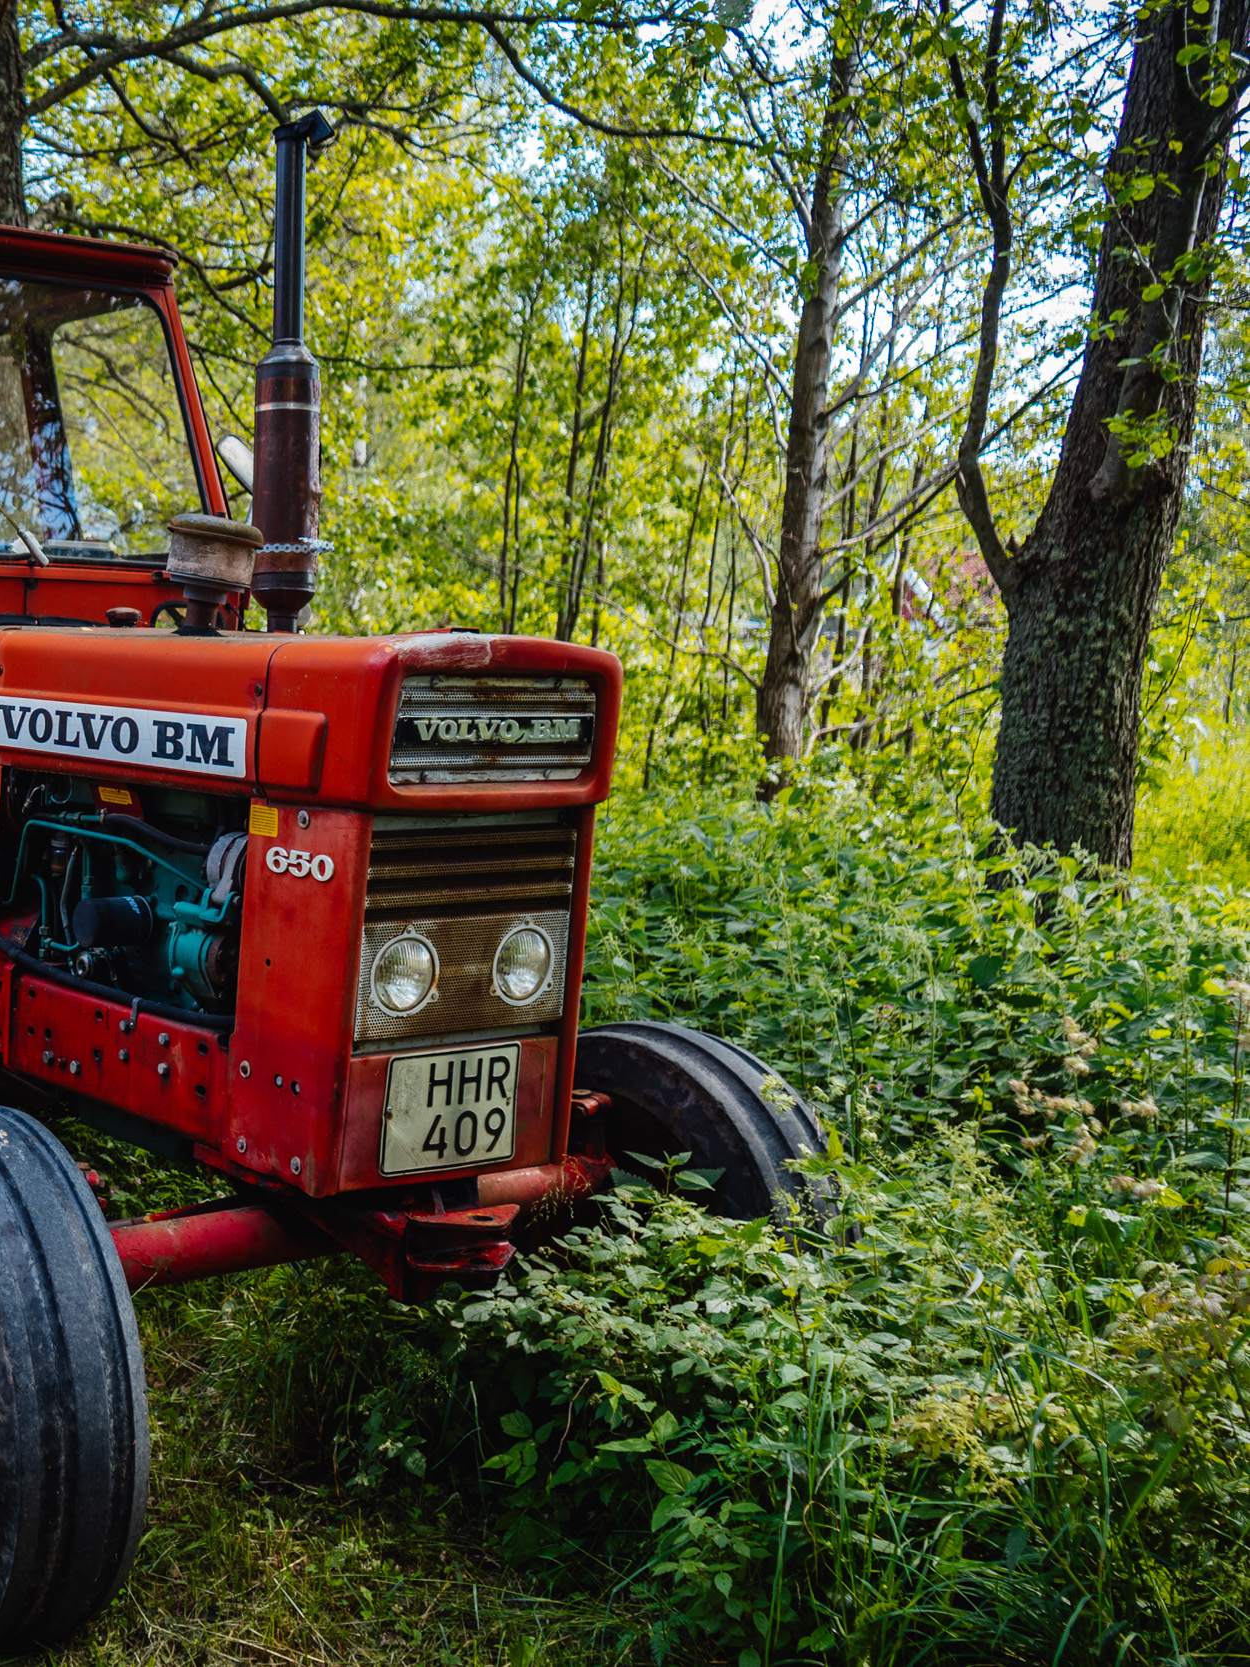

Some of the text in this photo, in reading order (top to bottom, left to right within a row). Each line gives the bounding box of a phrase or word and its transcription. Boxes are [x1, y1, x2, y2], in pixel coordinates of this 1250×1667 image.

[0, 704, 235, 768] VOLVO BM
[414, 718, 581, 741] VOLVO BM
[265, 846, 335, 882] 650
[427, 1055, 510, 1108] HHR
[422, 1107, 505, 1159] 409
